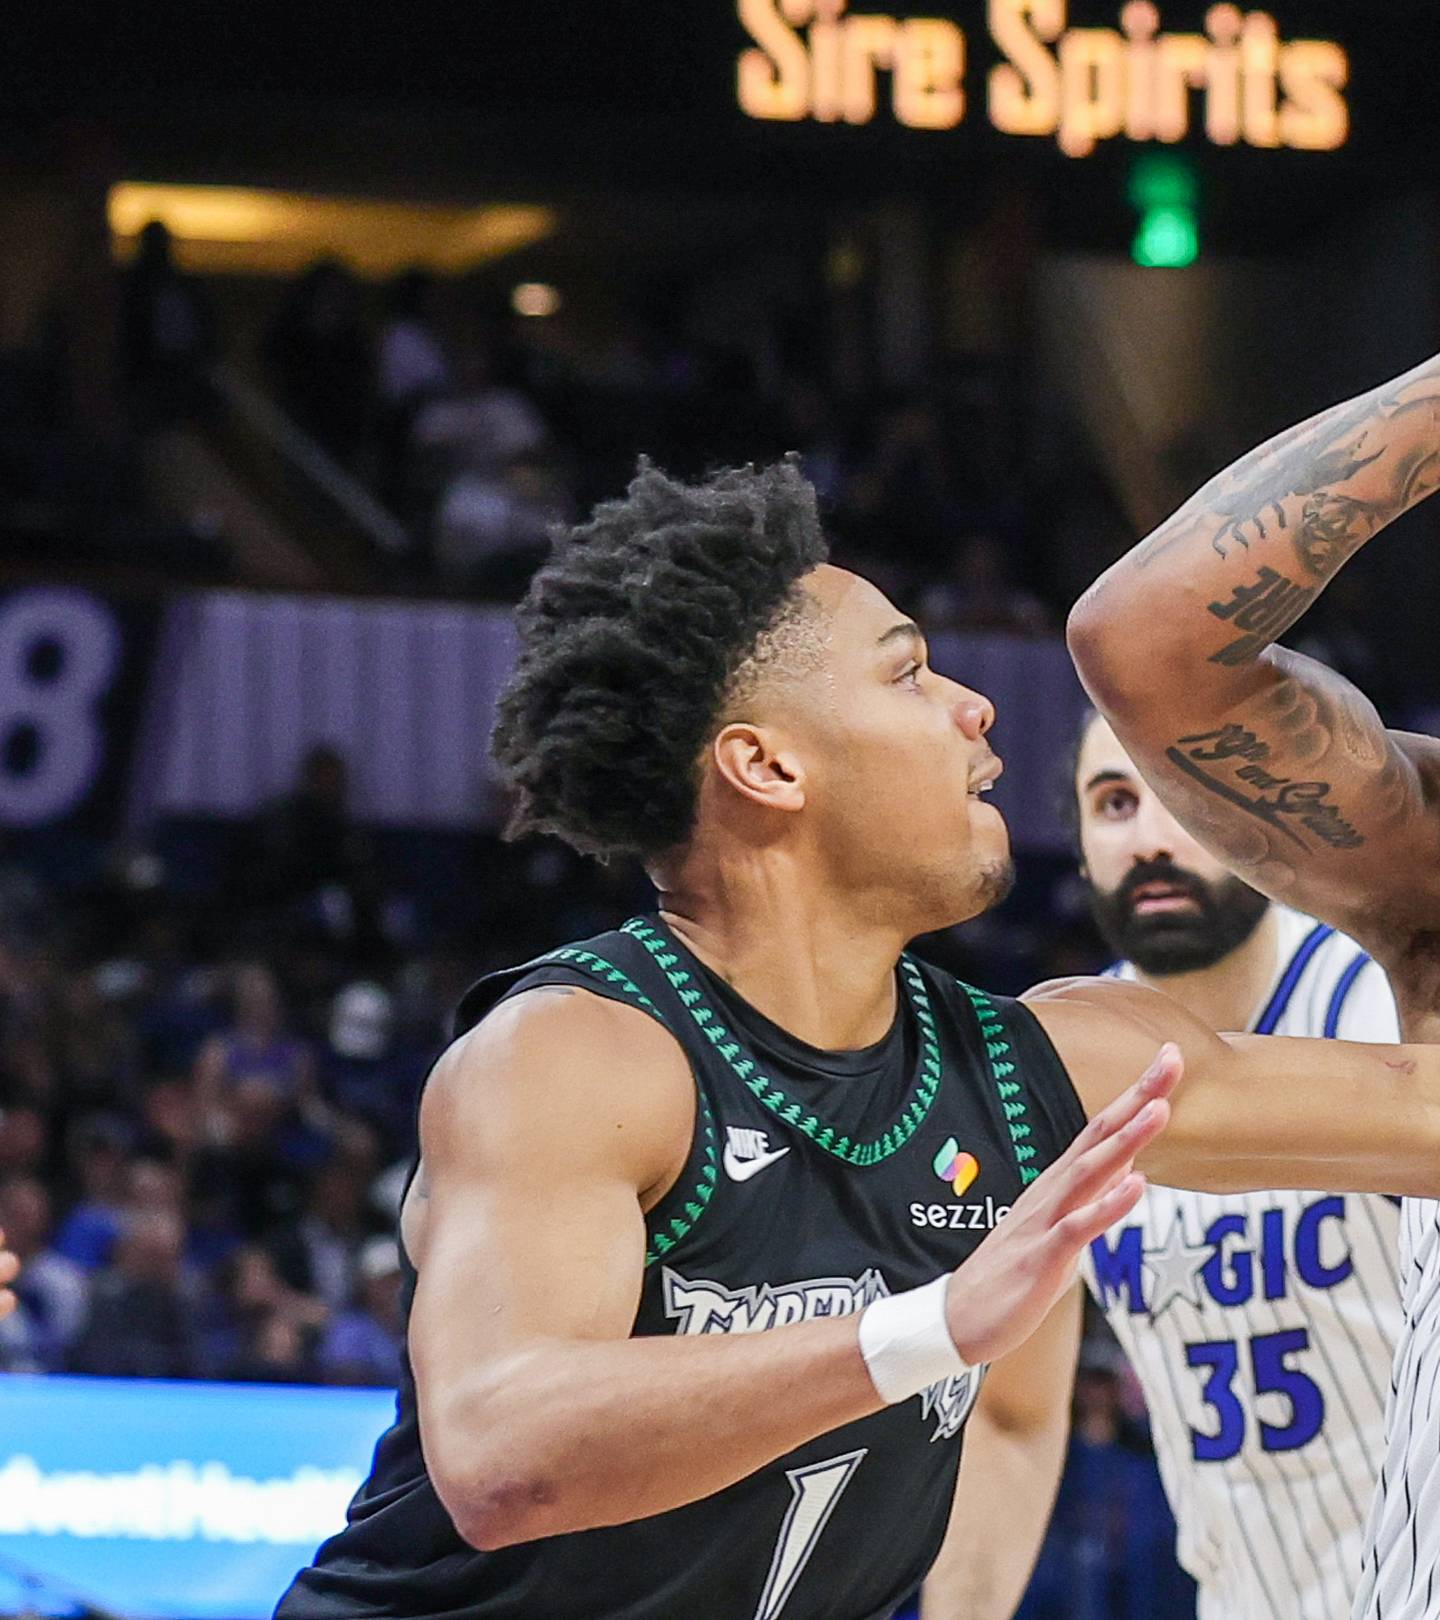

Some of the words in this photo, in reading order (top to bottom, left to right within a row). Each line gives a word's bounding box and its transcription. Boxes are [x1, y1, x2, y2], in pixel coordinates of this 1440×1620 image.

[737, 0, 967, 130] Sire
[987, 0, 1349, 158] Spirits
[1185, 1327, 1326, 1463] 35
